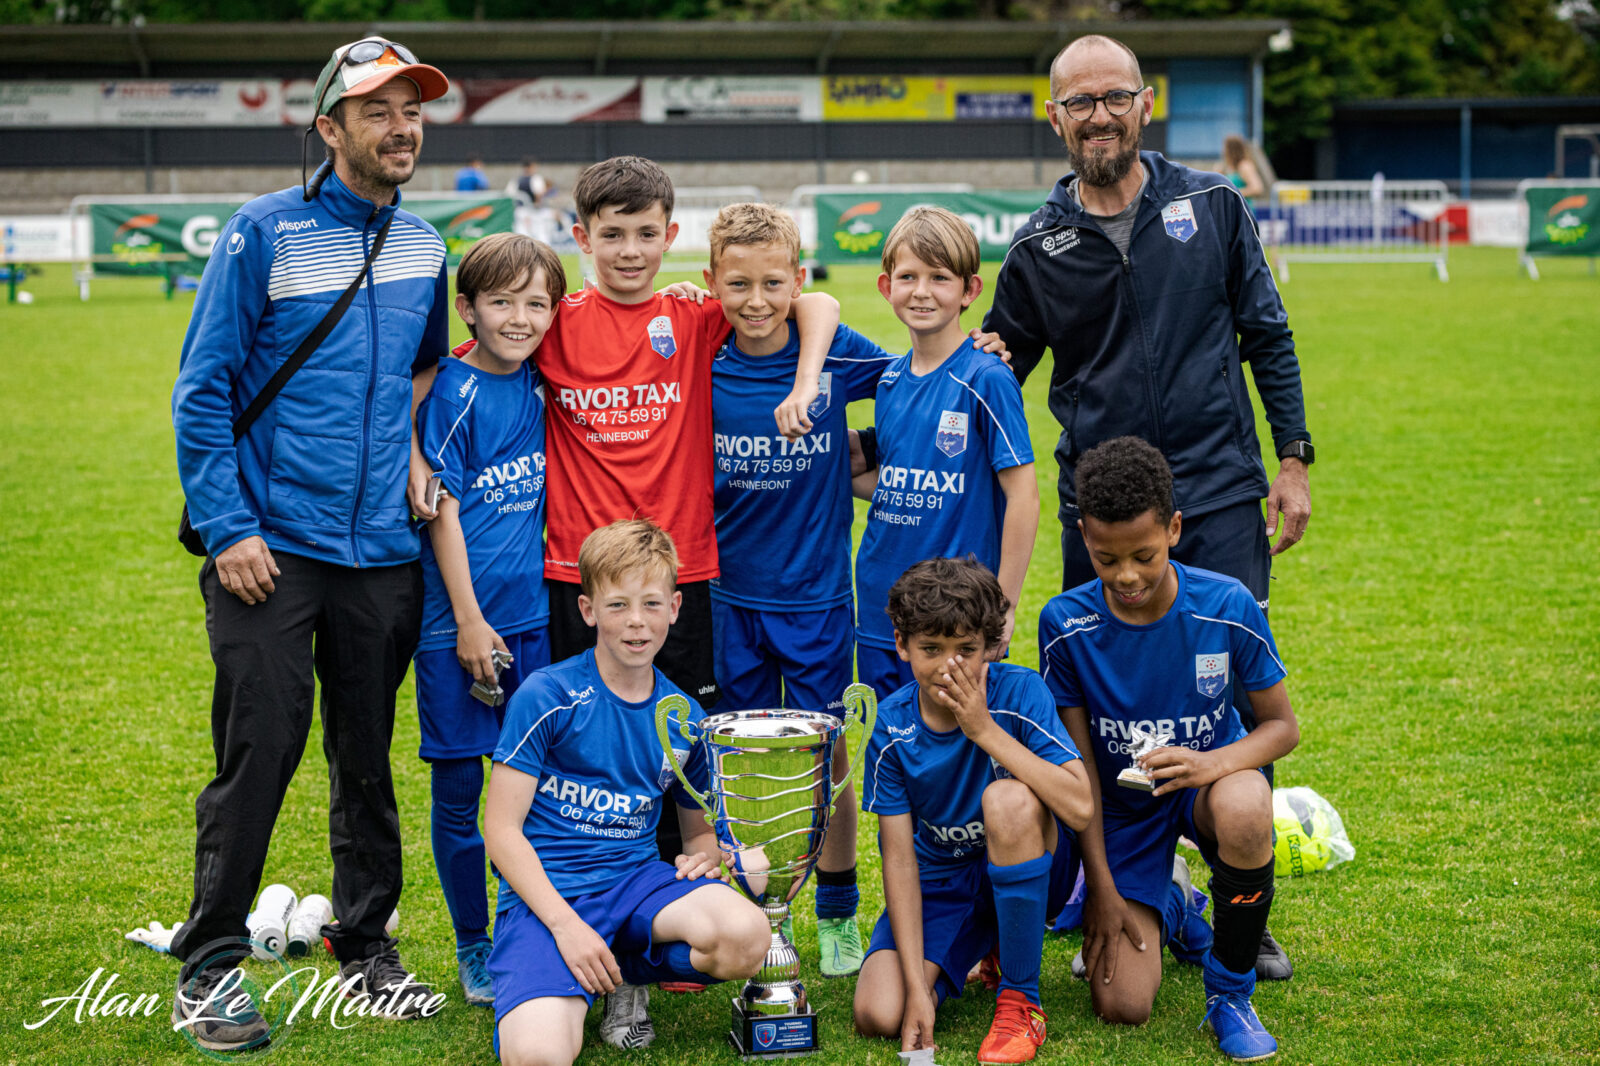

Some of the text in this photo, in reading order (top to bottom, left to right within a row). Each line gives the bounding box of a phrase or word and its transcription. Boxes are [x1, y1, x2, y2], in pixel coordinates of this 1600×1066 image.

[274, 218, 318, 234] uhlsport
[459, 373, 478, 398] uhlsport
[555, 382, 681, 410] RVOR TAXI
[589, 412, 608, 426] 74
[609, 411, 628, 424] 75
[630, 408, 649, 422] 59
[651, 407, 667, 421] 91
[586, 429, 650, 443] HENNEBONT
[714, 432, 831, 458] RVOR TAXI
[471, 456, 533, 489] RVOR
[718, 457, 812, 474] 06 74 75 59 91
[728, 479, 792, 491] HENNEBONT
[910, 468, 965, 494] TAXI
[484, 489, 504, 504] 06
[505, 483, 519, 497] 74
[519, 480, 531, 493] 75
[889, 492, 903, 507] 75
[905, 493, 924, 509] 59
[927, 494, 943, 510] 91
[874, 509, 922, 527] HENNEBONT
[1063, 613, 1101, 629] uhlsport
[538, 775, 631, 814] ARVOR
[560, 804, 584, 820] 06
[585, 812, 605, 825] 74
[609, 814, 628, 827] 75
[575, 823, 642, 840] HENNEBONT
